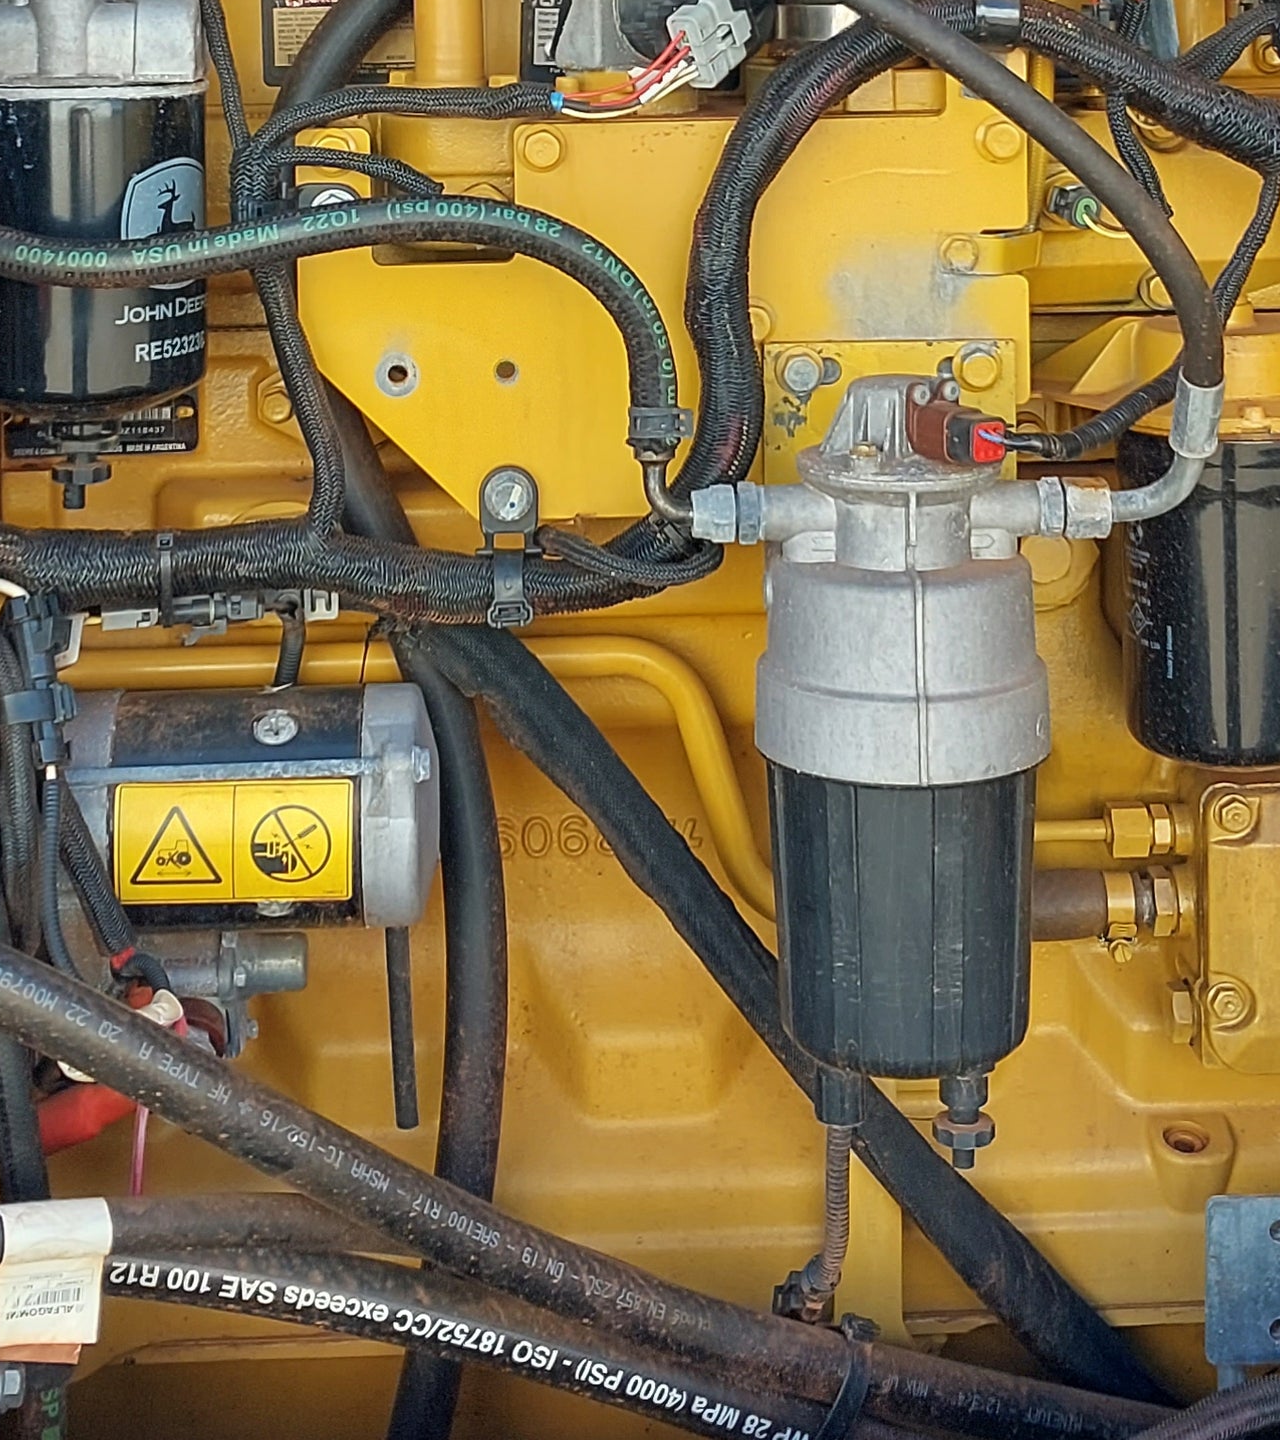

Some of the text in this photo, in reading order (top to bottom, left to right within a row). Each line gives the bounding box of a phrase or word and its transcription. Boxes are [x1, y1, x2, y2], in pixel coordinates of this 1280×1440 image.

[385, 200, 430, 220] psi)
[435, 201, 487, 220] (400
[491, 207, 531, 228] bar
[216, 222, 280, 249] Made
[535, 217, 563, 238] 28
[15, 244, 108, 267] 0001400
[132, 243, 183, 266] USA
[188, 237, 211, 257] in
[580, 239, 636, 288] DN12
[115, 292, 208, 325] JOHN DEE
[138, 1041, 153, 1062] A
[158, 1052, 201, 1090] TYPE
[208, 1081, 232, 1106] HF
[349, 1158, 391, 1195] MSHA
[447, 1210, 501, 1250] SAE100
[520, 1245, 540, 1269] 19
[544, 1256, 566, 1281] DN
[108, 1260, 161, 1290] R12
[165, 1266, 212, 1294] 100
[222, 1273, 278, 1304] SAE
[585, 1273, 612, 1298] 2SC
[282, 1283, 390, 1322] exceeds
[616, 1288, 642, 1310] 857
[391, 1306, 507, 1359] 18752/CC
[510, 1339, 560, 1371] ISO
[574, 1356, 625, 1394] PSI)
[625, 1374, 689, 1415] (4000
[691, 1394, 741, 1430] MPa
[743, 1413, 773, 1440] 28
